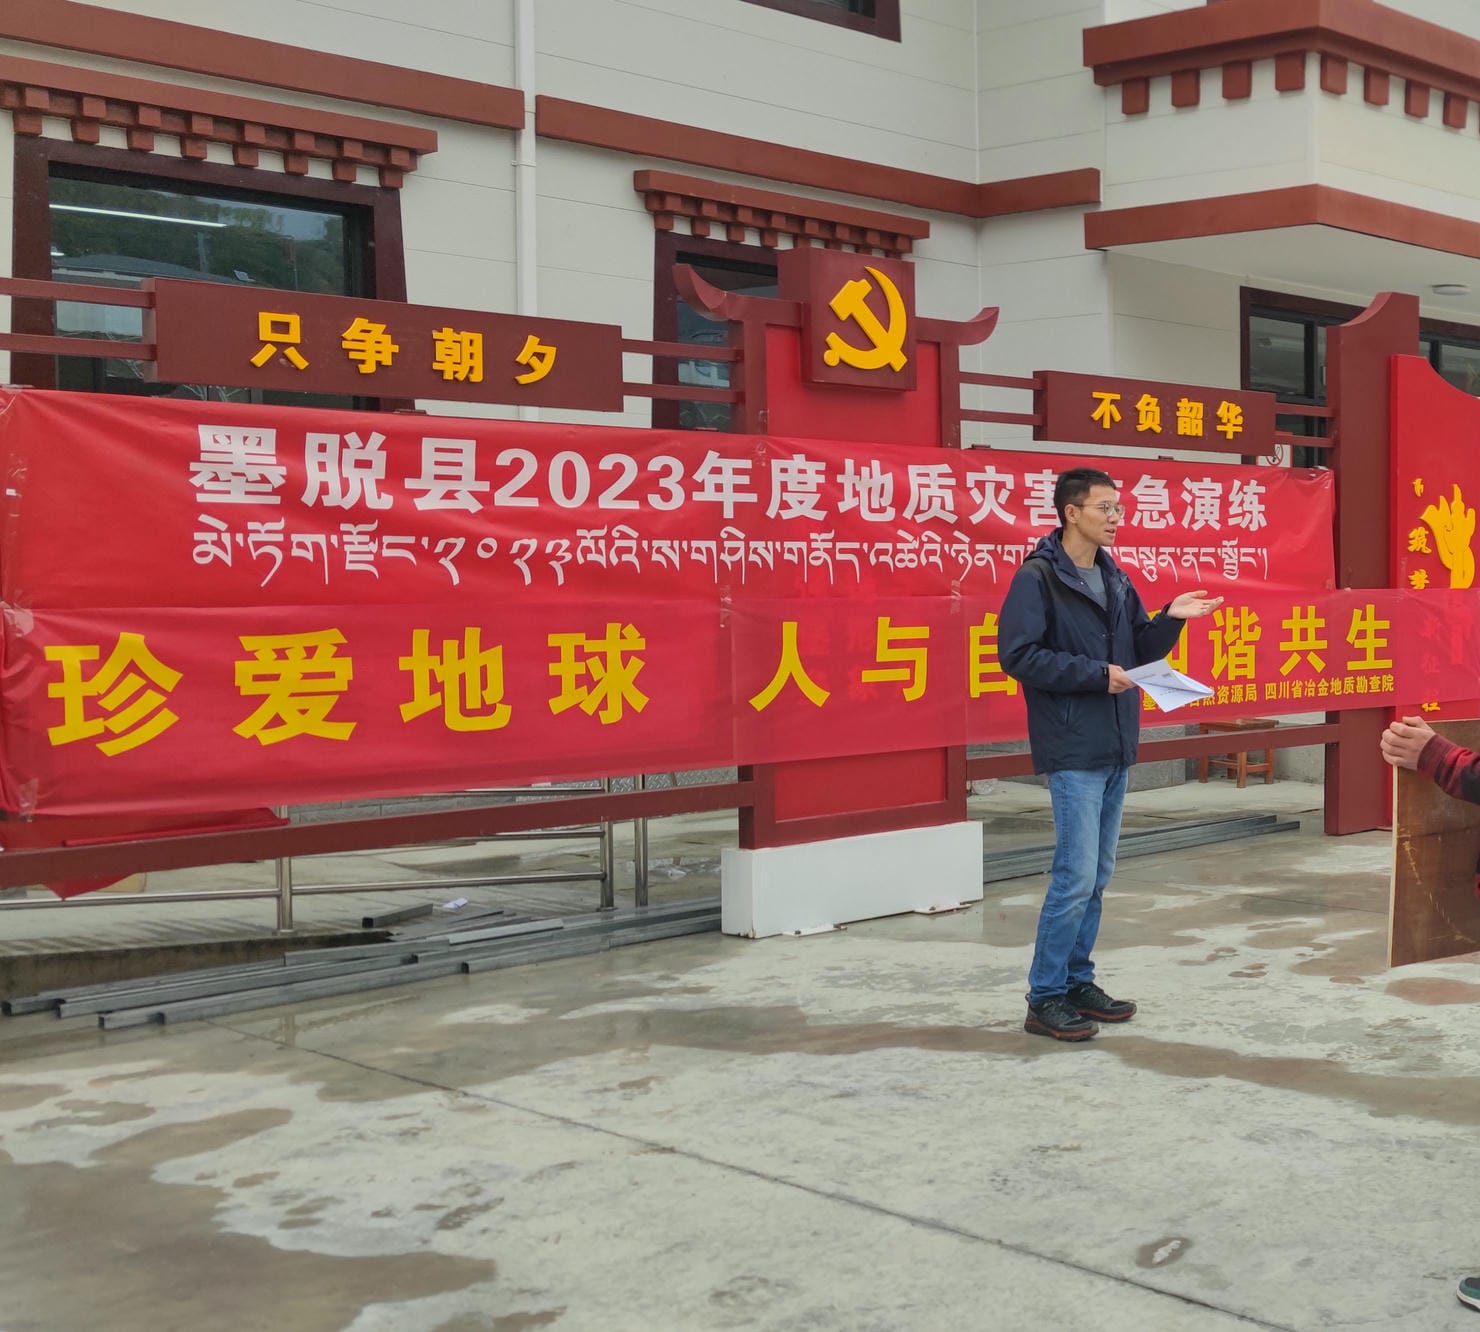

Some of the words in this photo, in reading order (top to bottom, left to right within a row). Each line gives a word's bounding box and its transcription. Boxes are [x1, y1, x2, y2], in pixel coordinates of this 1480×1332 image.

[250, 311, 558, 385] 只争朝夕
[1091, 391, 1245, 440] 不负韶华
[189, 423, 1267, 532] 墨脱县2023年度地质灾害急演练
[44, 622, 650, 757] 珍爱地球
[749, 603, 1393, 714] 人与自谐共生
[1265, 673, 1394, 700] 四川省冶金地质勘查院
